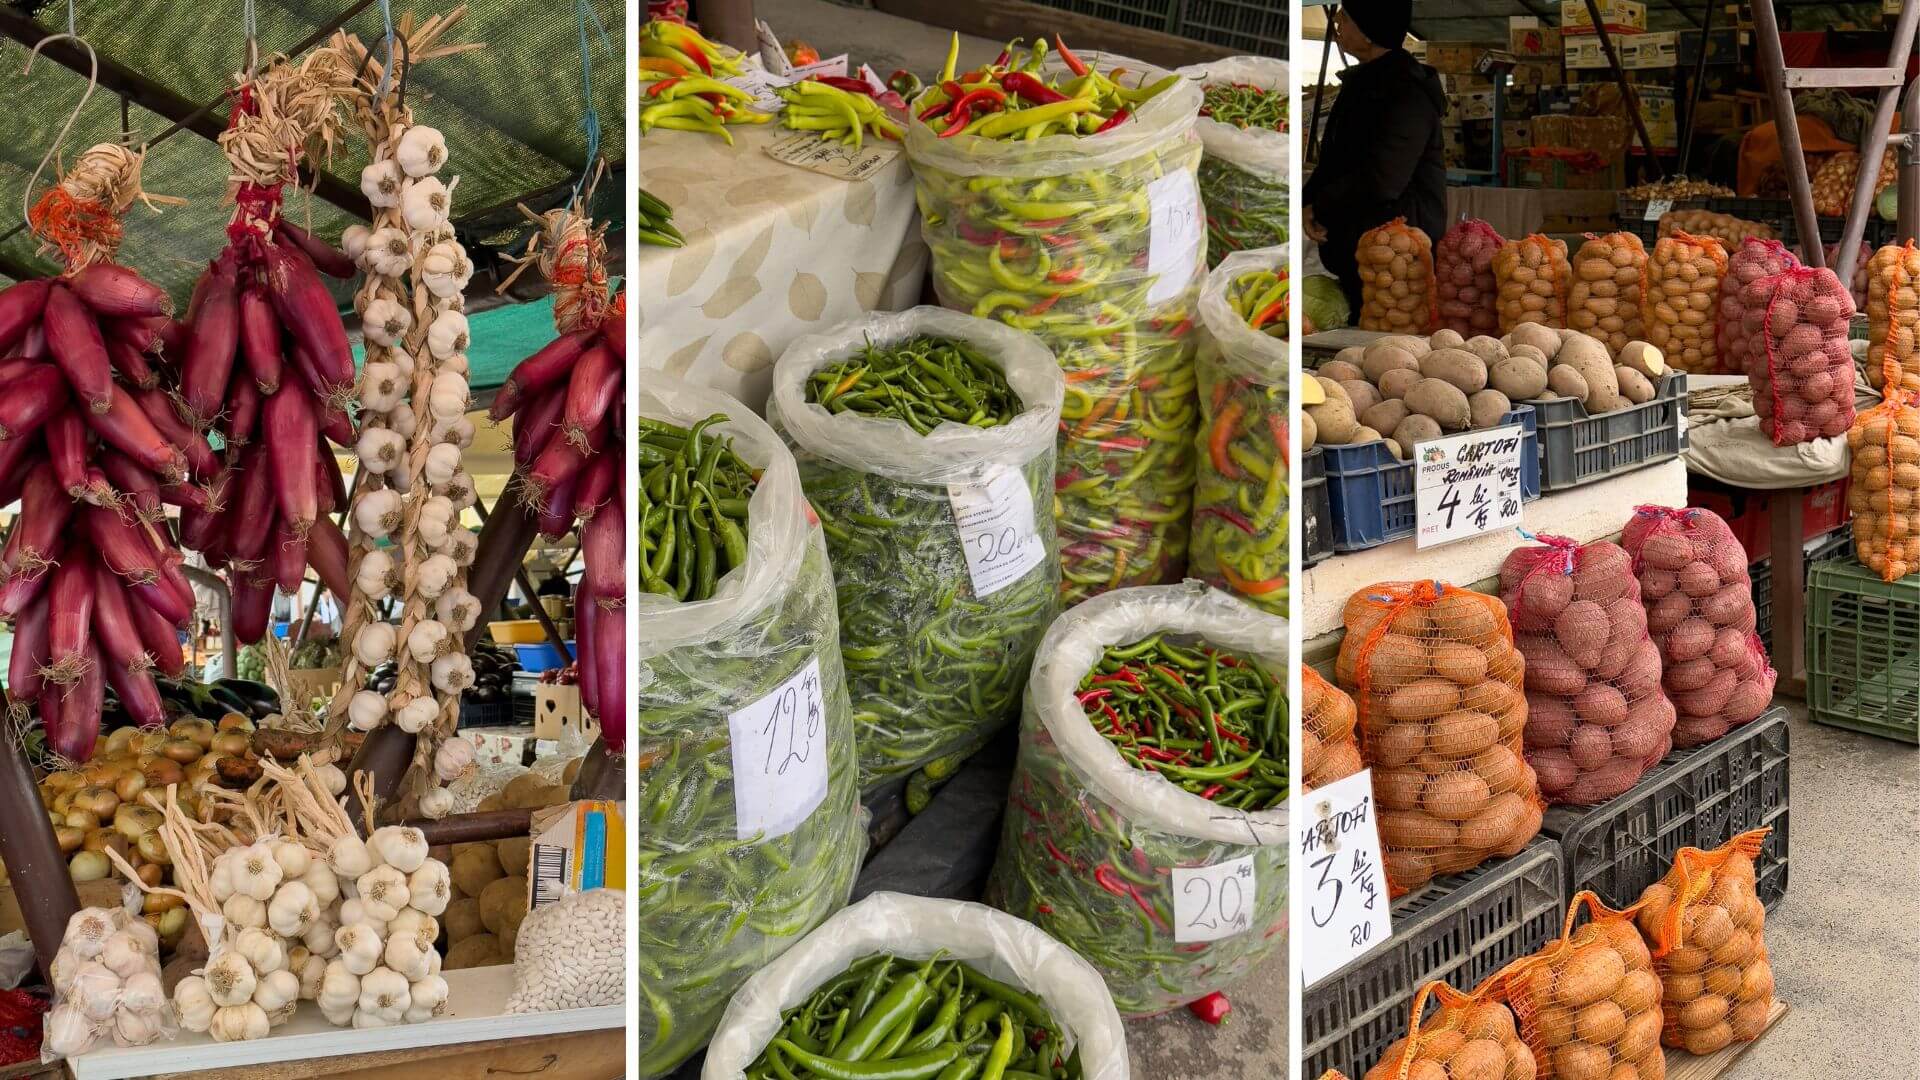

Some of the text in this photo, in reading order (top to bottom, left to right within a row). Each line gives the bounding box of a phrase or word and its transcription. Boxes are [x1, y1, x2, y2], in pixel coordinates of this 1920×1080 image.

[1422, 462, 1450, 473] PRODUS
[1437, 484, 1461, 530] 4
[977, 526, 1016, 564] 20
[763, 686, 810, 776] 12
[1301, 796, 1369, 855] ARTOFI
[1184, 875, 1242, 930] 20
[1310, 853, 1343, 928] 3
